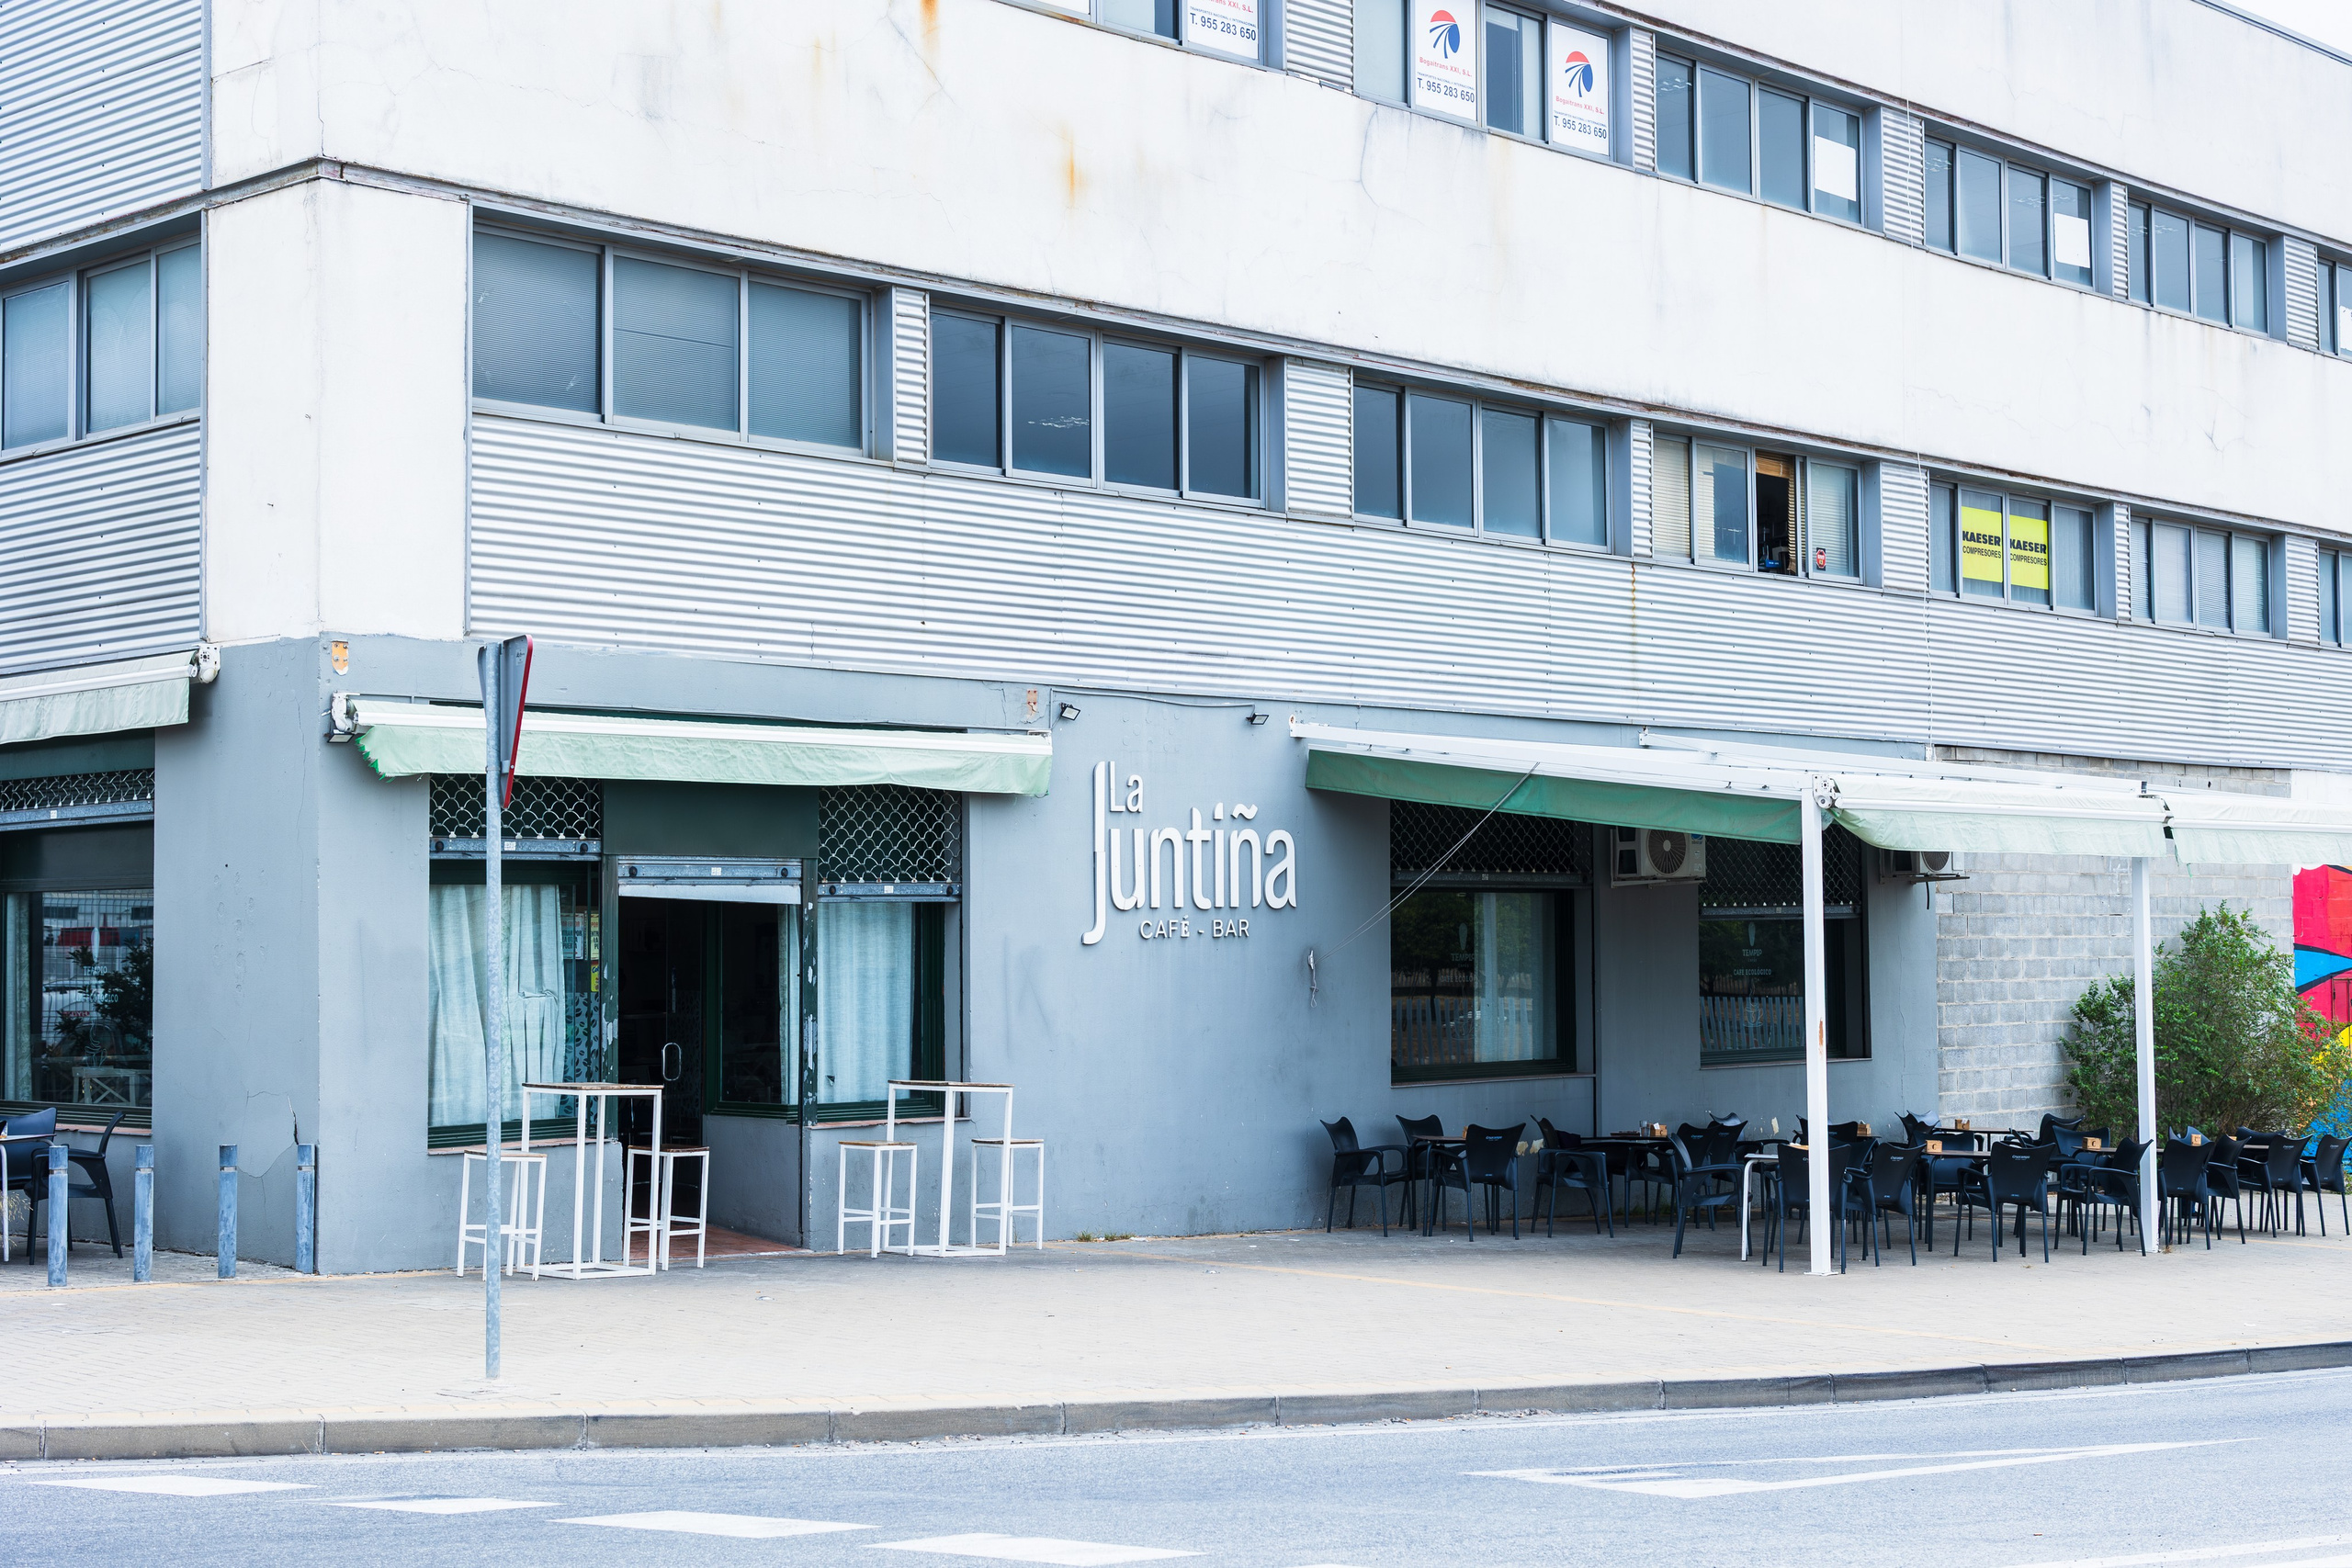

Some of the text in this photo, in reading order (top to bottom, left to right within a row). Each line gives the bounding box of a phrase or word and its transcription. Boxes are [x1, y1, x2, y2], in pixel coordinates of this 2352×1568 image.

[1190, 13, 1256, 40] T. 955 283 650
[1419, 57, 1449, 71] Bogaitrans
[1417, 77, 1475, 103] T. 955 283 650
[1554, 115, 1560, 127] T.
[1562, 118, 1577, 131] 955
[1578, 122, 1591, 135] 283
[1593, 127, 1607, 140] 650
[1962, 530, 2001, 547] KAESER
[2009, 538, 2047, 554] KAESER
[1962, 546, 2001, 558] COMPRESORES
[2010, 553, 2047, 566] COMPRESORES
[1108, 761, 1144, 812] La
[1081, 761, 1297, 945] Juntiña
[1139, 914, 1191, 940] CAFÉ
[1212, 919, 1250, 939] BAR
